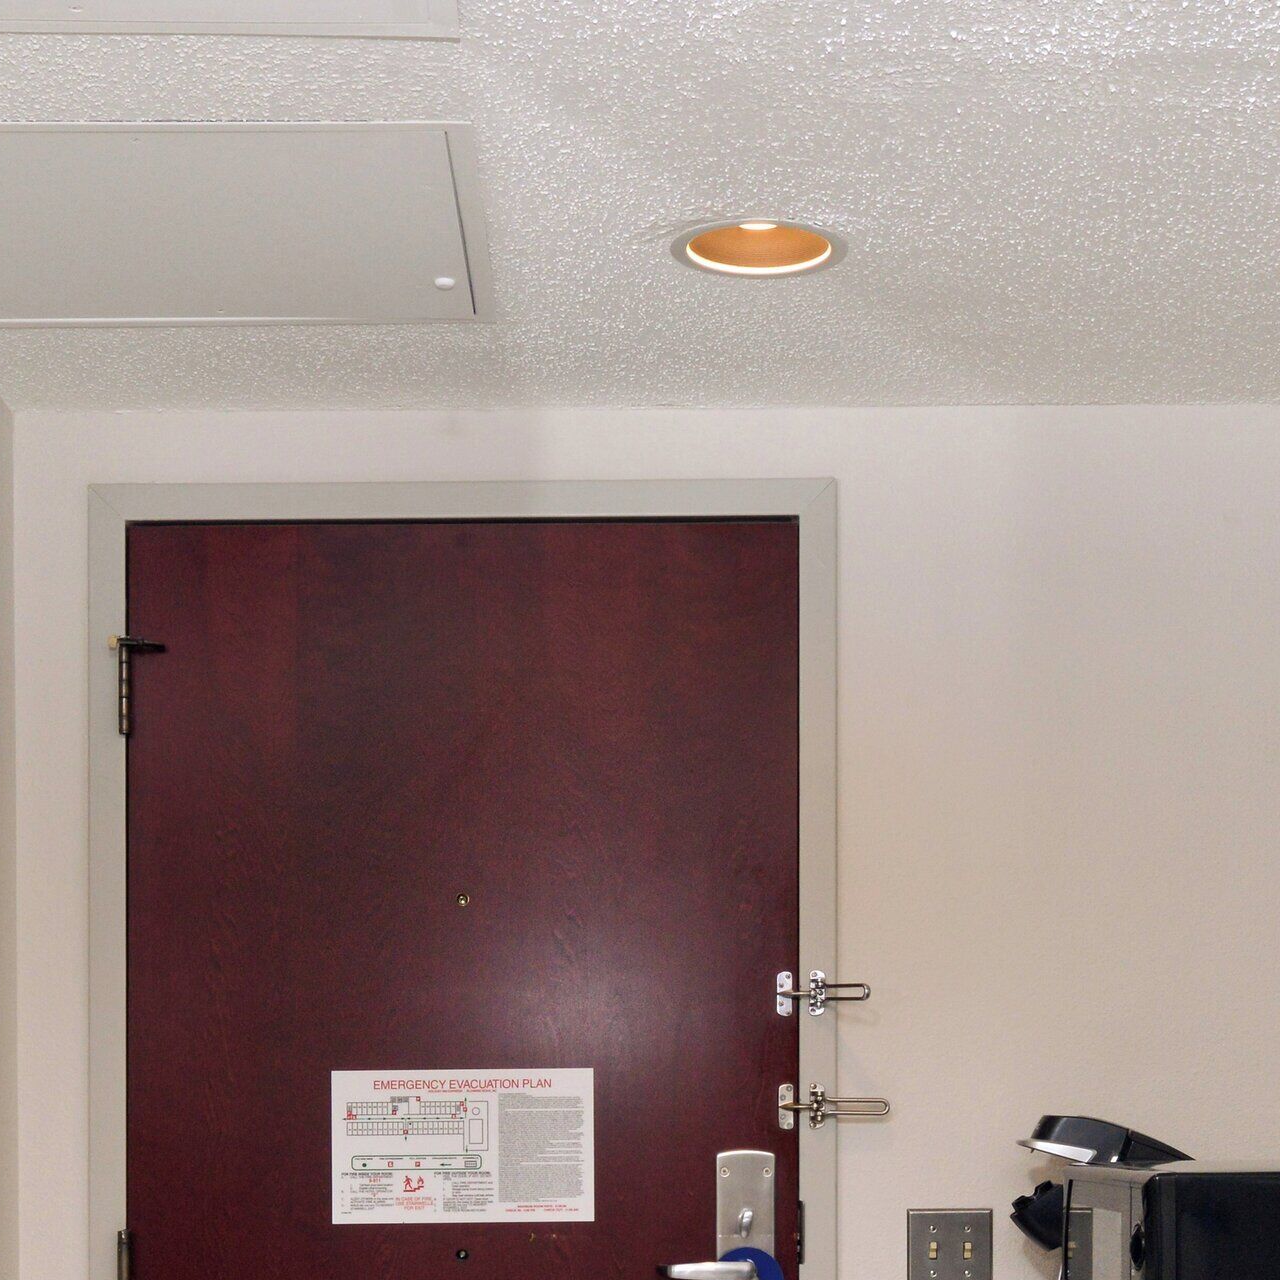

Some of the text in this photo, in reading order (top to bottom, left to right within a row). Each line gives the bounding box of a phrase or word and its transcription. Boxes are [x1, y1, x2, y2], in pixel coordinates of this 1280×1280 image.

[373, 1078, 552, 1090] EMERGENCY EVACUATION PLAN
